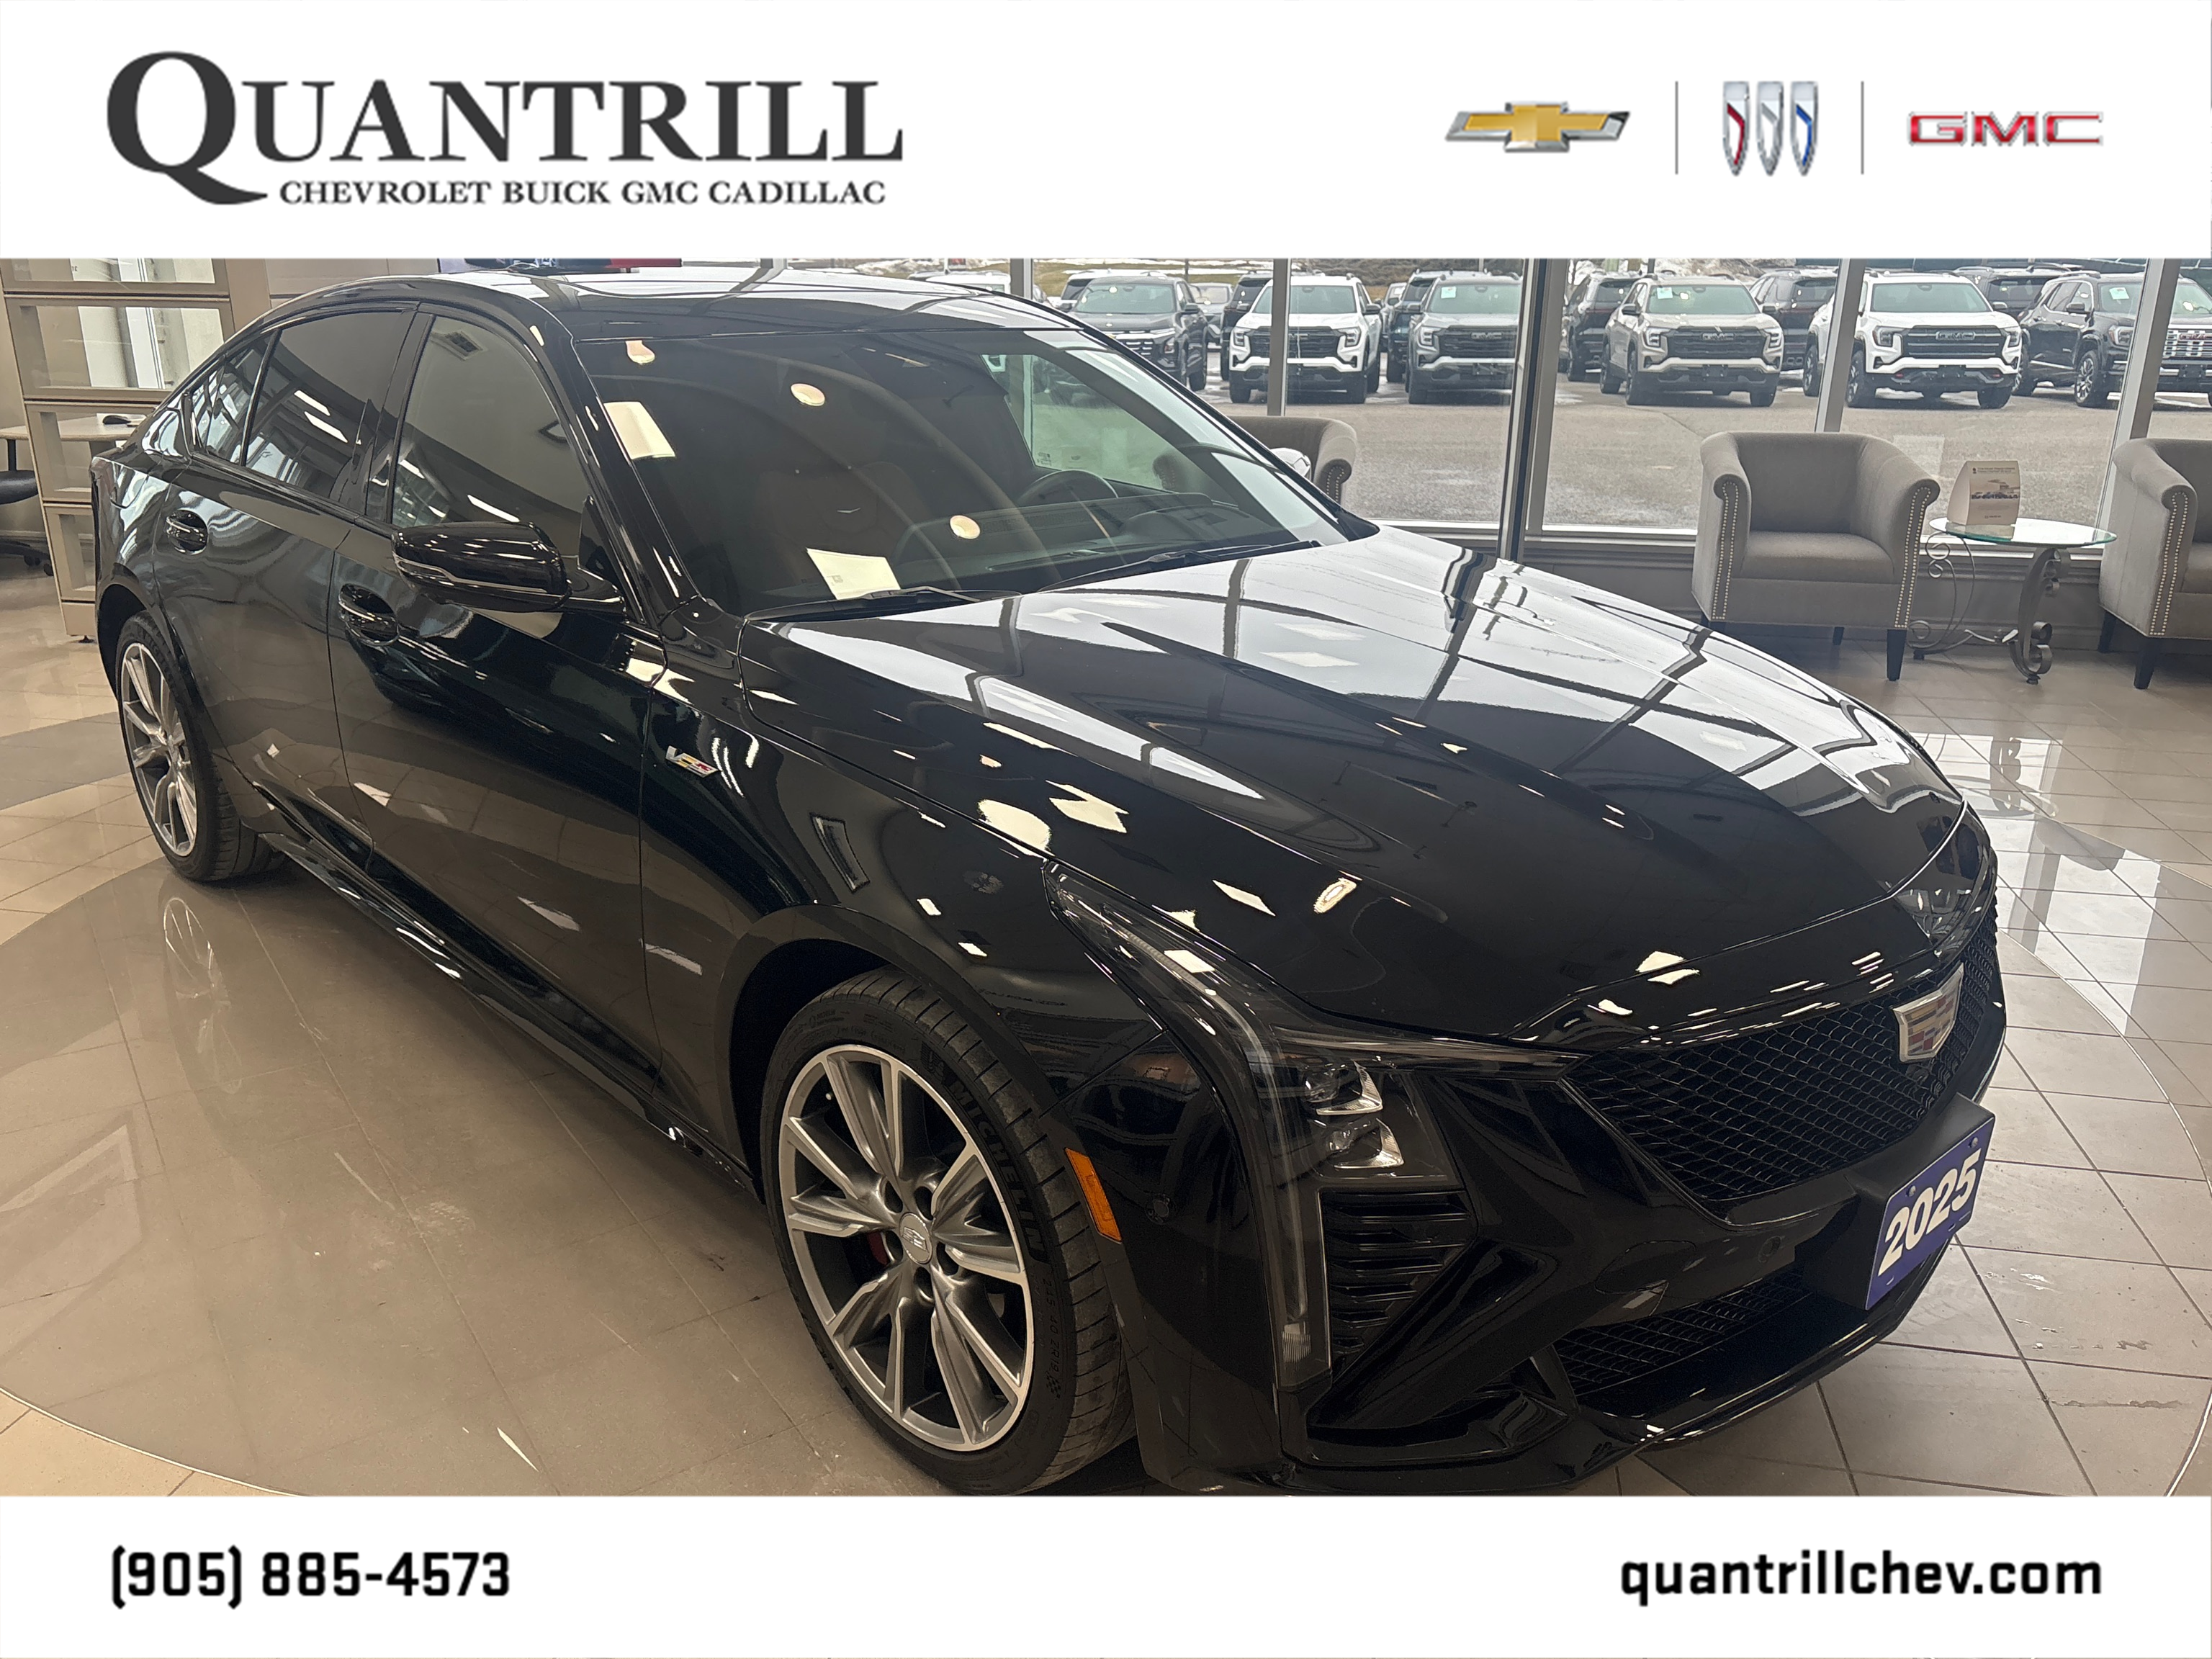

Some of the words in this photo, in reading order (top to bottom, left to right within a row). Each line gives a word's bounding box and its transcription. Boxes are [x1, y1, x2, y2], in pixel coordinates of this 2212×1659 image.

[1939, 332, 1974, 341] GMC
[948, 1081, 1043, 1249] MICHELIN
[1877, 1147, 1982, 1277] 2025
